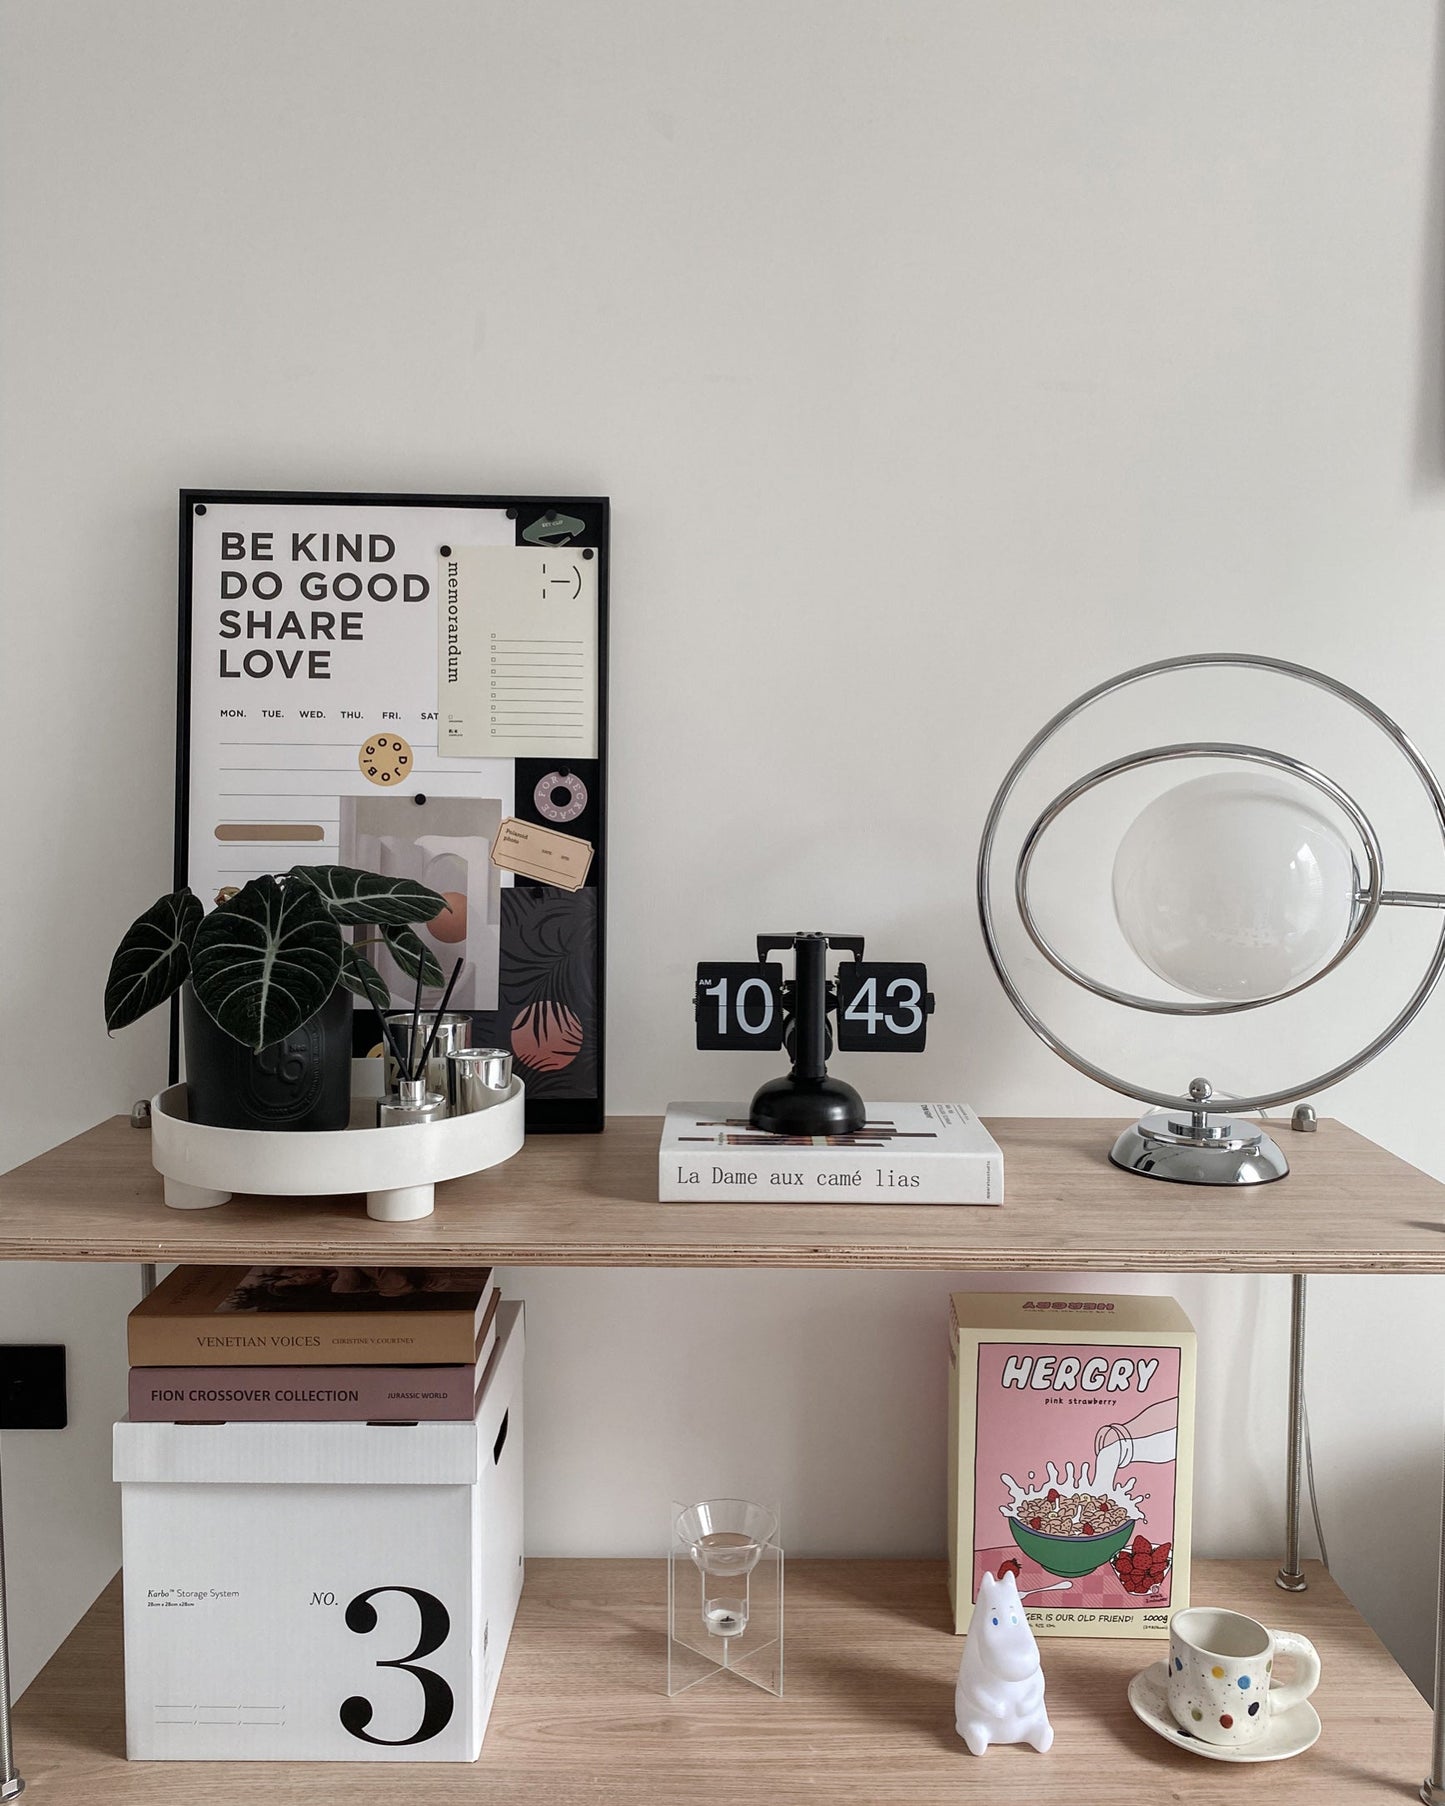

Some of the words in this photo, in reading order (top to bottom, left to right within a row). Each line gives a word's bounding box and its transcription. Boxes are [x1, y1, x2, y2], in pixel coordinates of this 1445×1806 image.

[221, 531, 273, 561] BE
[292, 533, 396, 563] KIND
[220, 571, 283, 600] DO
[300, 572, 430, 602] GOOD
[218, 609, 364, 640] SHARE
[448, 562, 461, 683] memorandum
[219, 649, 331, 679] LOVE
[219, 709, 247, 718] MON.
[261, 710, 285, 719] TUE.
[299, 710, 326, 719] WED.
[340, 711, 364, 719] THU.
[382, 711, 401, 720] FRI.
[365, 738, 408, 764] GOOD
[538, 775, 559, 798] FOR
[699, 978, 712, 986] AM
[705, 977, 774, 1035] 10
[844, 977, 923, 1035] 43
[677, 1166, 700, 1184] La
[711, 1166, 758, 1185] Dame
[770, 1172, 804, 1185] aux
[816, 1170, 862, 1187] camé
[875, 1169, 921, 1187] lias
[196, 1336, 267, 1347] VENETIAN
[271, 1336, 321, 1347] VOICES
[1002, 1355, 1159, 1393] HERGRY
[151, 1389, 185, 1402] FION
[188, 1389, 271, 1402] CROSSOVER
[274, 1389, 359, 1402] COLLECTION
[387, 1391, 420, 1399] JURASSIC
[421, 1391, 448, 1399] WORLD
[1044, 1396, 1064, 1405] pink
[1068, 1397, 1118, 1407] strawberry
[176, 1588, 208, 1600] Storage
[209, 1588, 240, 1599] System
[309, 1591, 339, 1606] NO.
[1046, 1613, 1053, 1622] IS
[1055, 1614, 1075, 1622] OUR
[1077, 1614, 1096, 1622] OLD
[1098, 1614, 1134, 1623] FRIEND!
[1143, 1614, 1168, 1624] 1000g
[339, 1585, 454, 1747] 3
